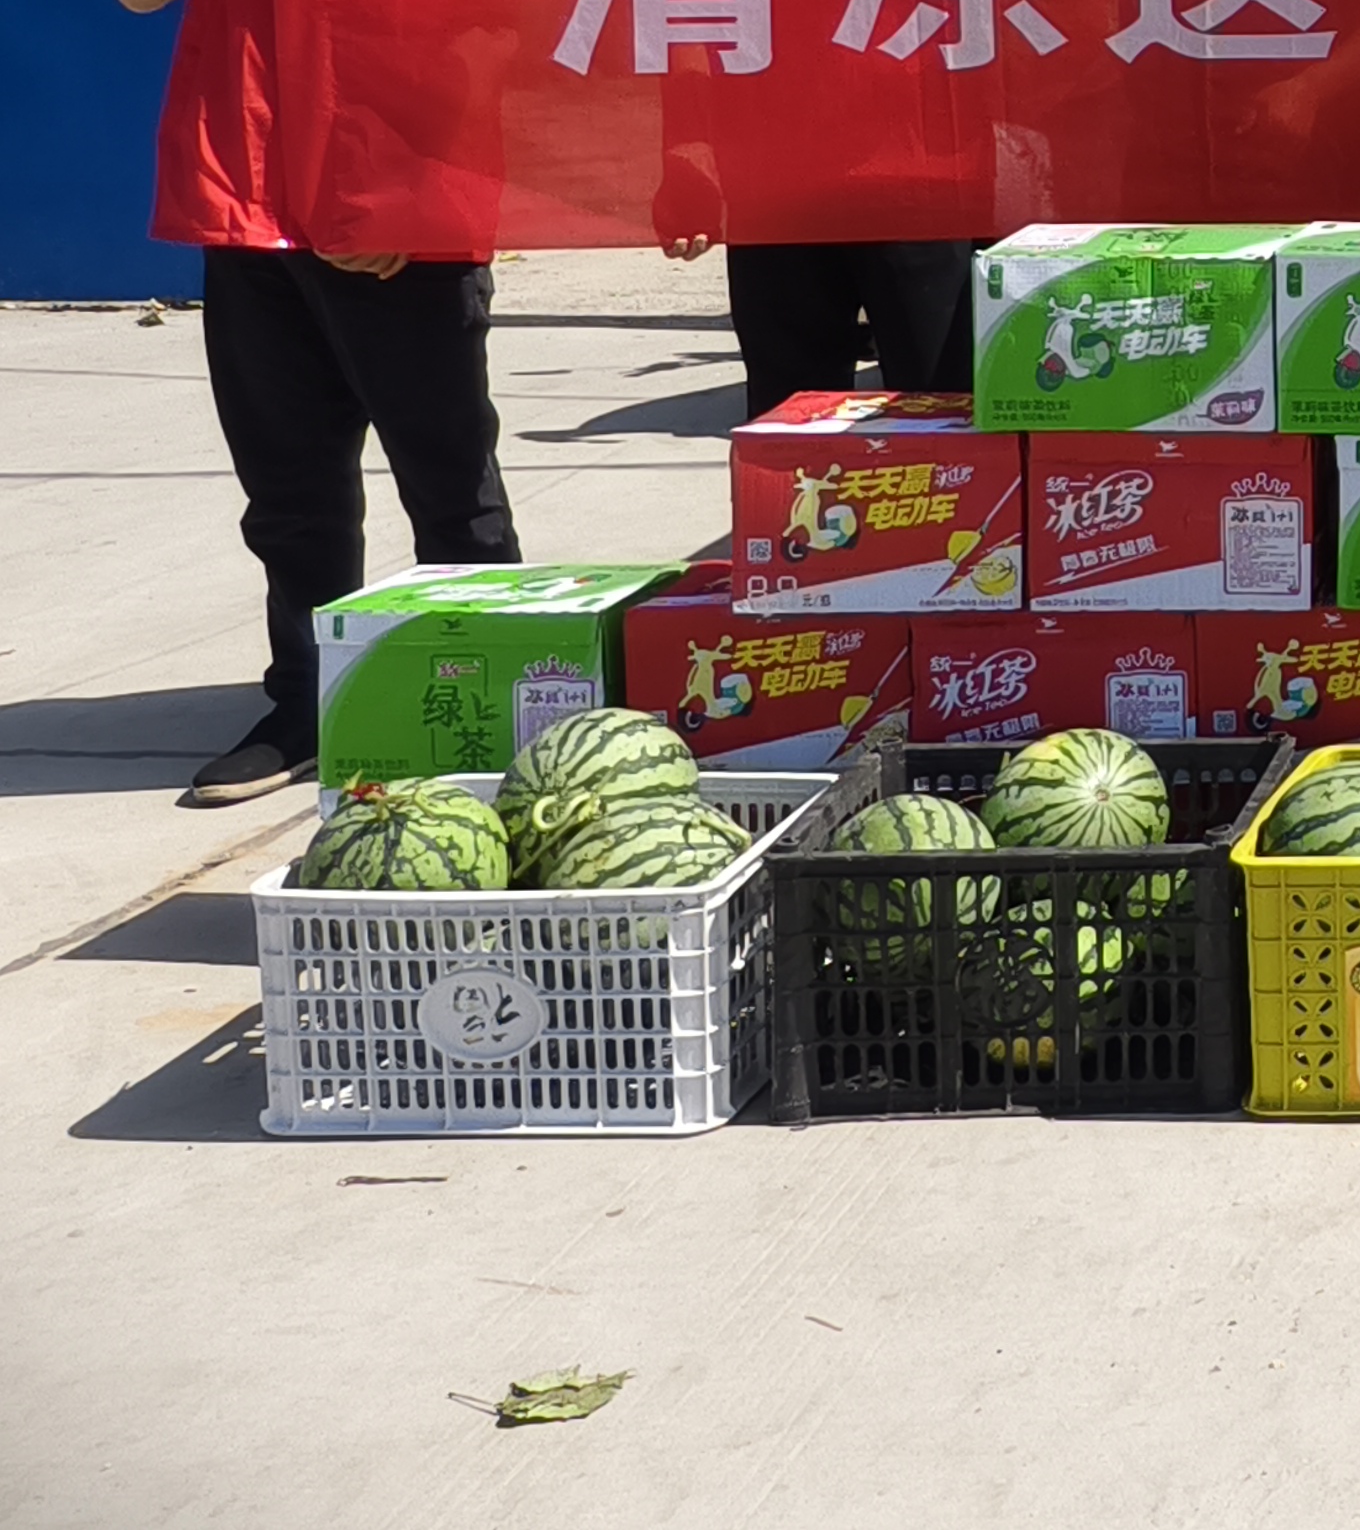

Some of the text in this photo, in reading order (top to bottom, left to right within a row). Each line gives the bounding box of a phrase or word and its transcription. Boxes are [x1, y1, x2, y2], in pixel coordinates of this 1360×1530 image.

[1119, 324, 1210, 361] 电动车
[837, 463, 936, 500] 天天赢
[865, 493, 959, 530] 电动车
[1044, 470, 1153, 542] 冰红茶
[760, 660, 850, 697] 电动车
[929, 648, 1036, 720] 冰红茶
